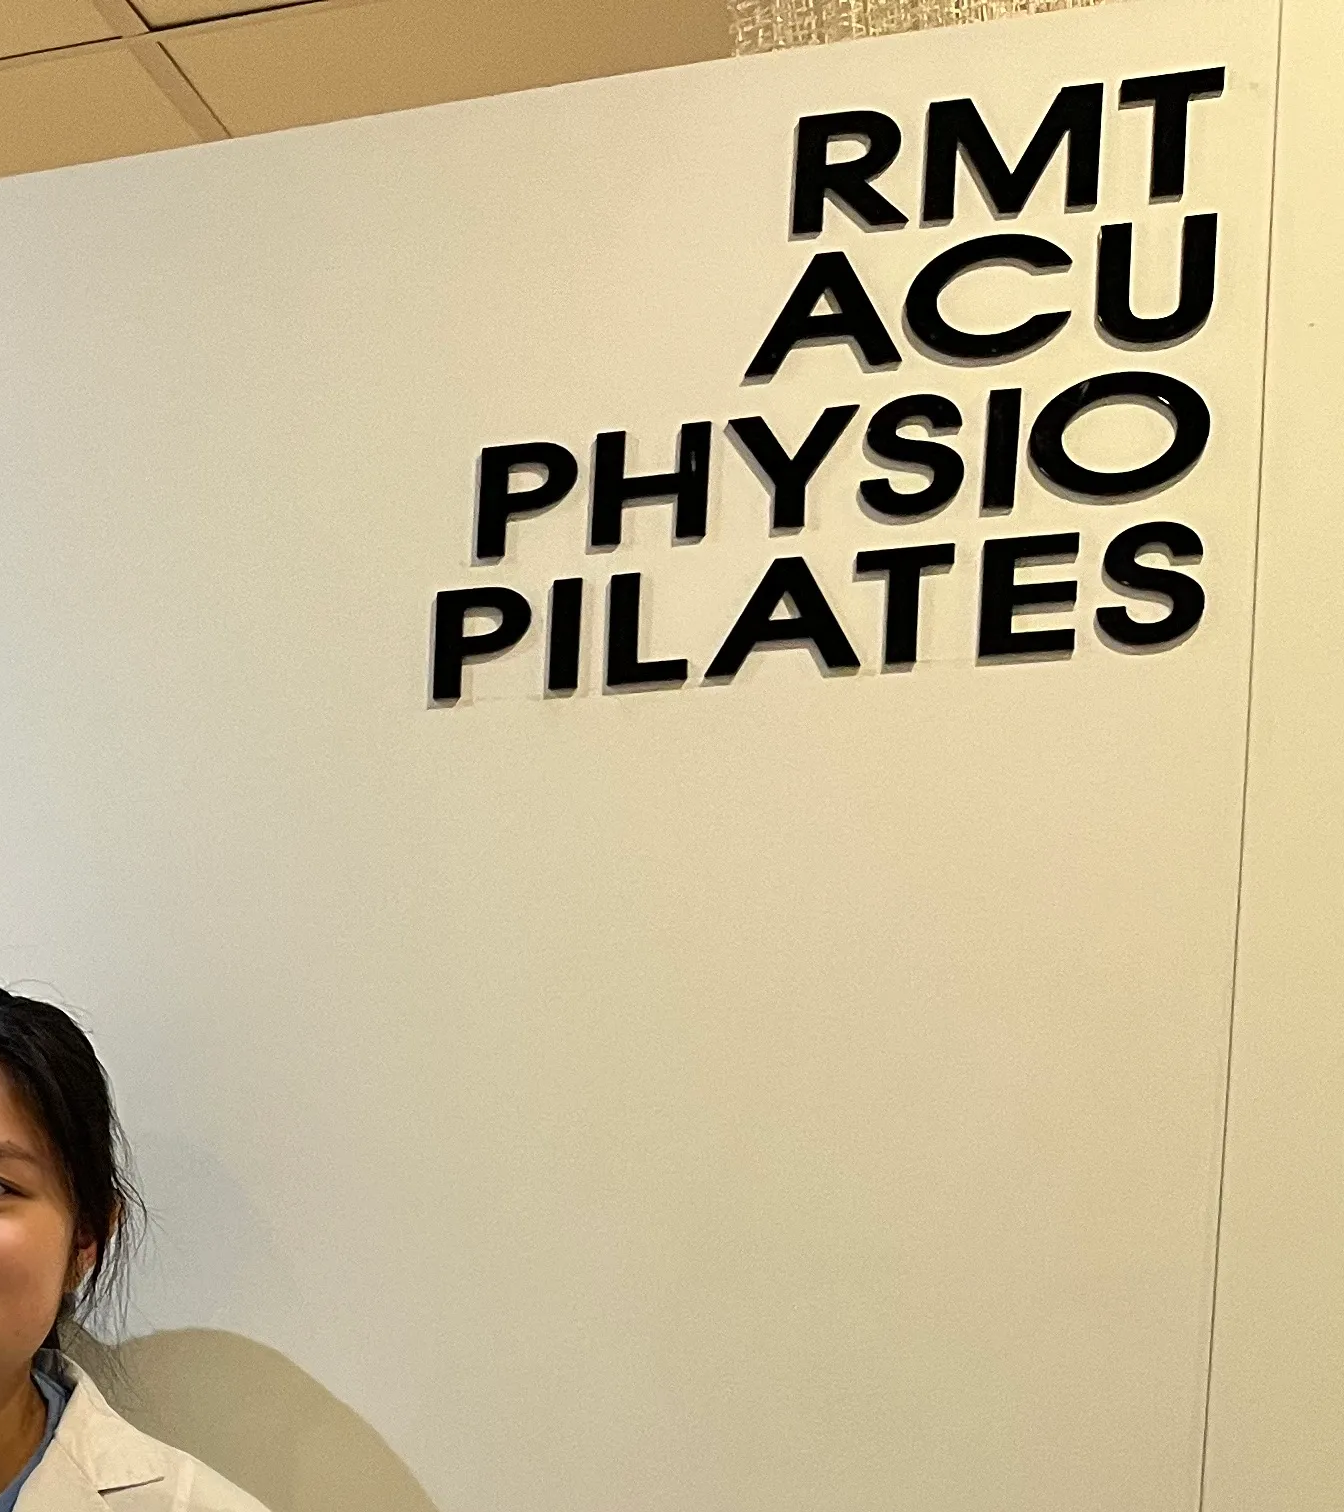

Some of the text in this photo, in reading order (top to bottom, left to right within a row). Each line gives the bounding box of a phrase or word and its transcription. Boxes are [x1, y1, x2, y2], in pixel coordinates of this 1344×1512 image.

[791, 66, 1226, 237] RMT
[743, 212, 1219, 380] ACU
[475, 371, 1212, 562] PHYSIO
[431, 521, 1206, 703] PILATES
